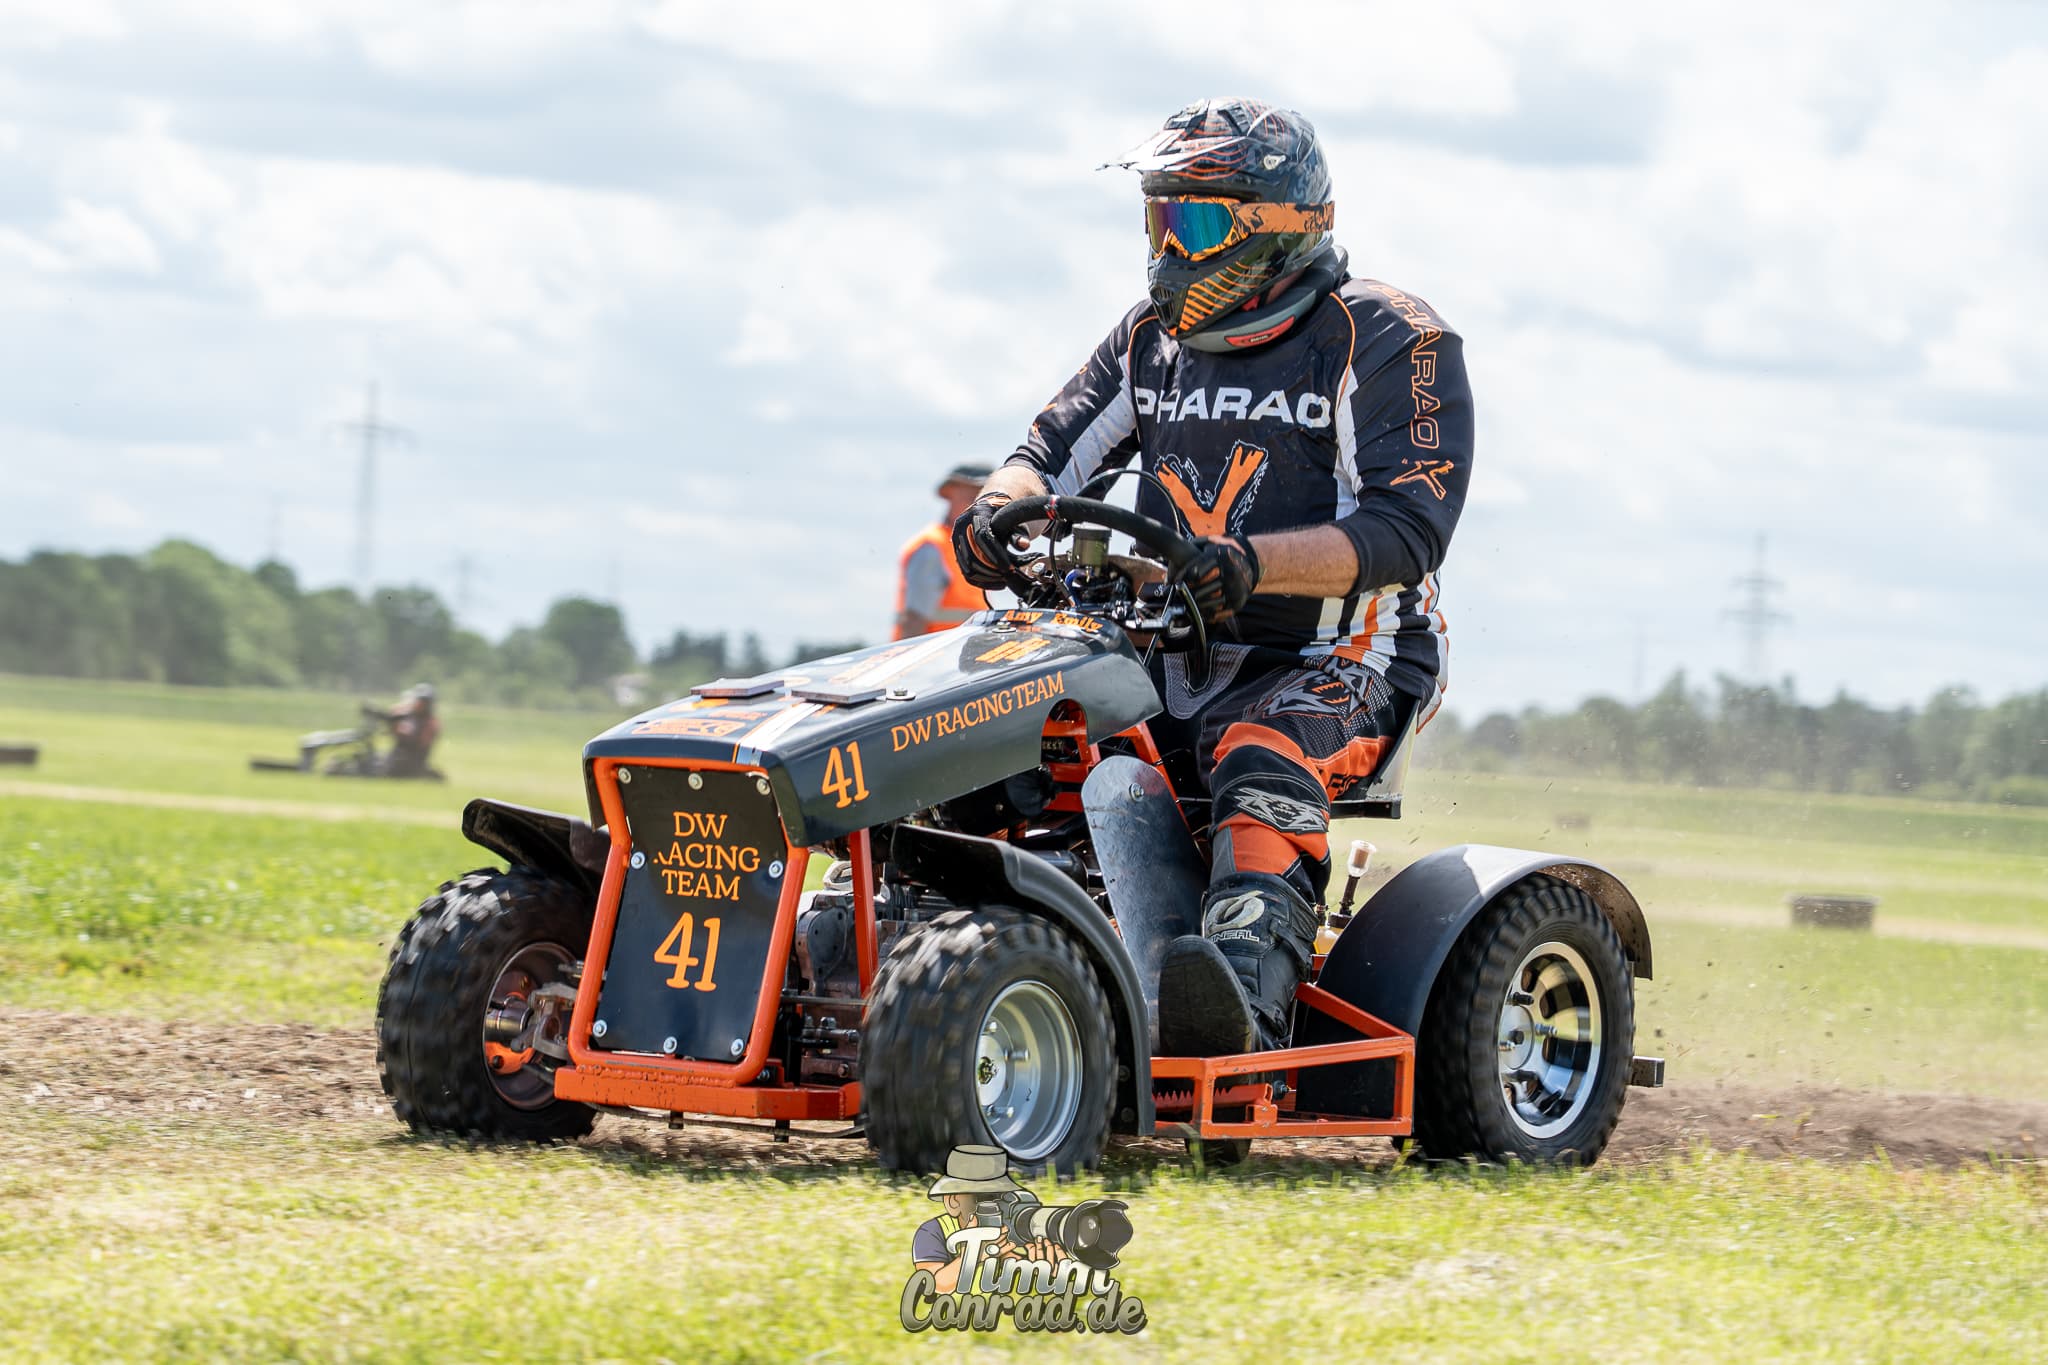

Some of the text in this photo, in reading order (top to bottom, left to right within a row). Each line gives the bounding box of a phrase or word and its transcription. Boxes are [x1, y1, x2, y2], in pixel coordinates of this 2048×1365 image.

[1367, 284, 1442, 449] PHARAO
[1134, 386, 1331, 428] PHARAO
[1002, 609, 1043, 624] Amy
[1051, 612, 1104, 633] Emily
[891, 670, 1065, 752] DW RACING TEAM
[821, 740, 870, 808] 41
[673, 811, 728, 839] DW
[661, 869, 741, 901] TEAM
[654, 911, 721, 992] 41
